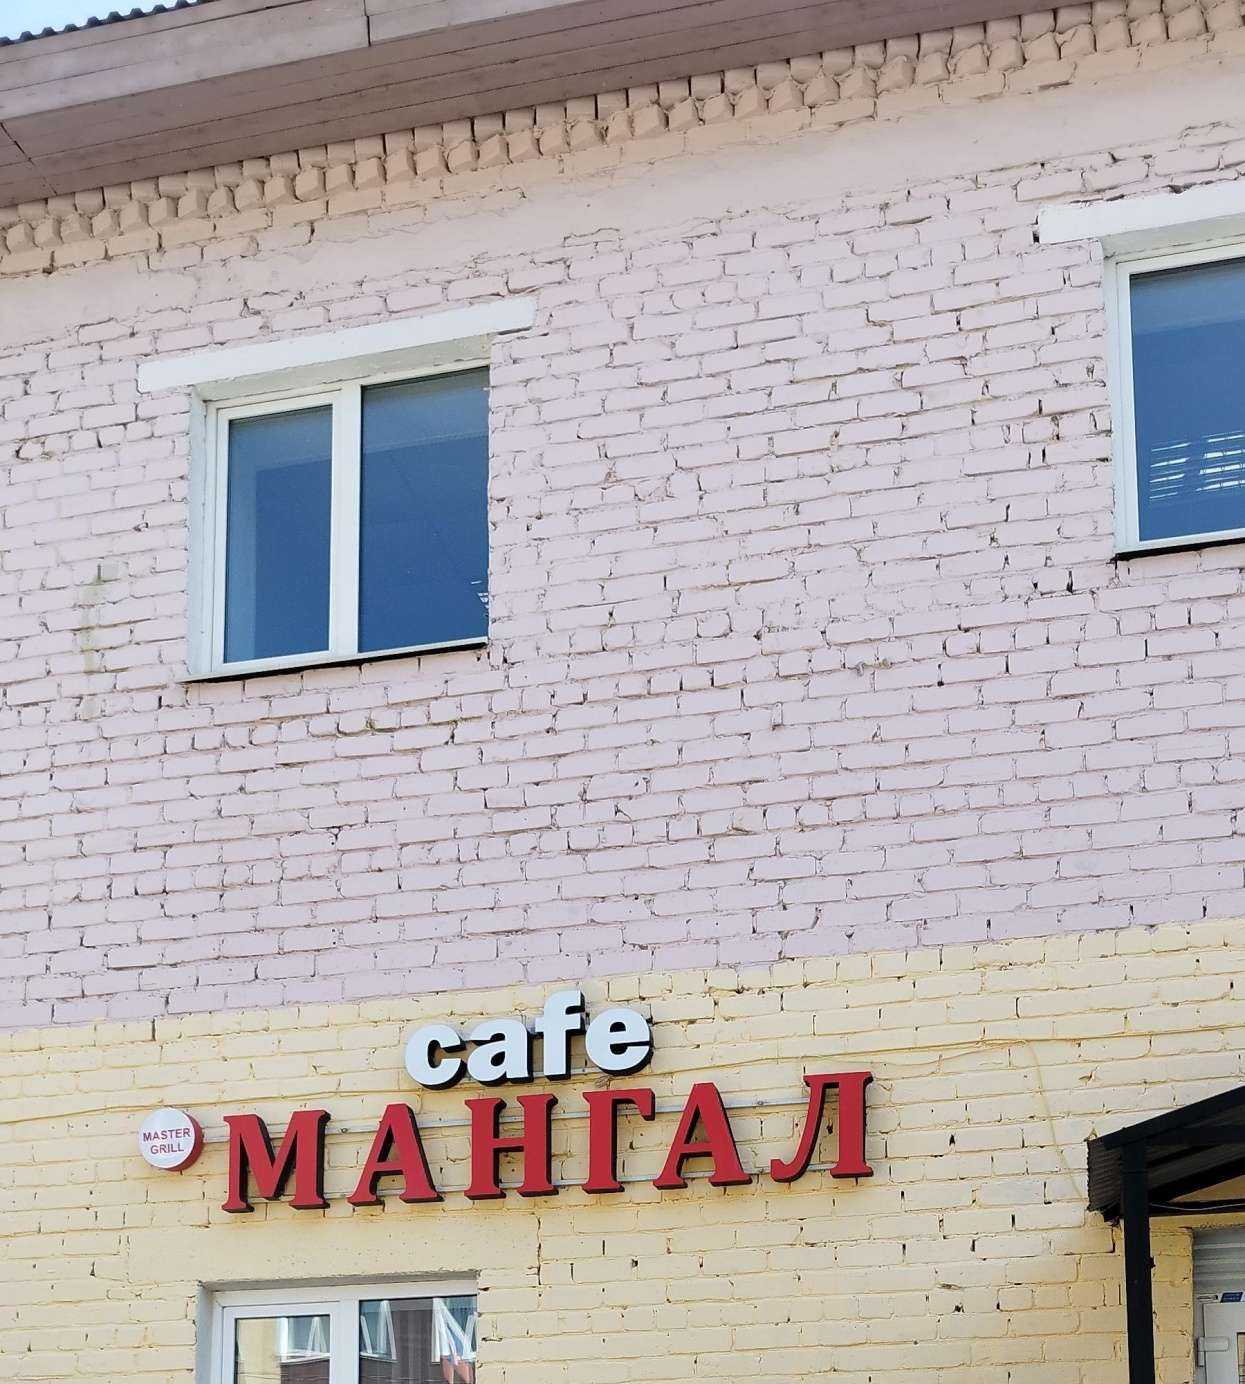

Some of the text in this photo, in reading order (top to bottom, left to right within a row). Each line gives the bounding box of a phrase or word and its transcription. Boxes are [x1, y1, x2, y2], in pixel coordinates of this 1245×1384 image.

[405, 991, 654, 1089] cafe
[143, 1128, 190, 1142] MASTER
[150, 1143, 184, 1154] GRILL
[222, 1071, 873, 1213] МАНГАЛ
